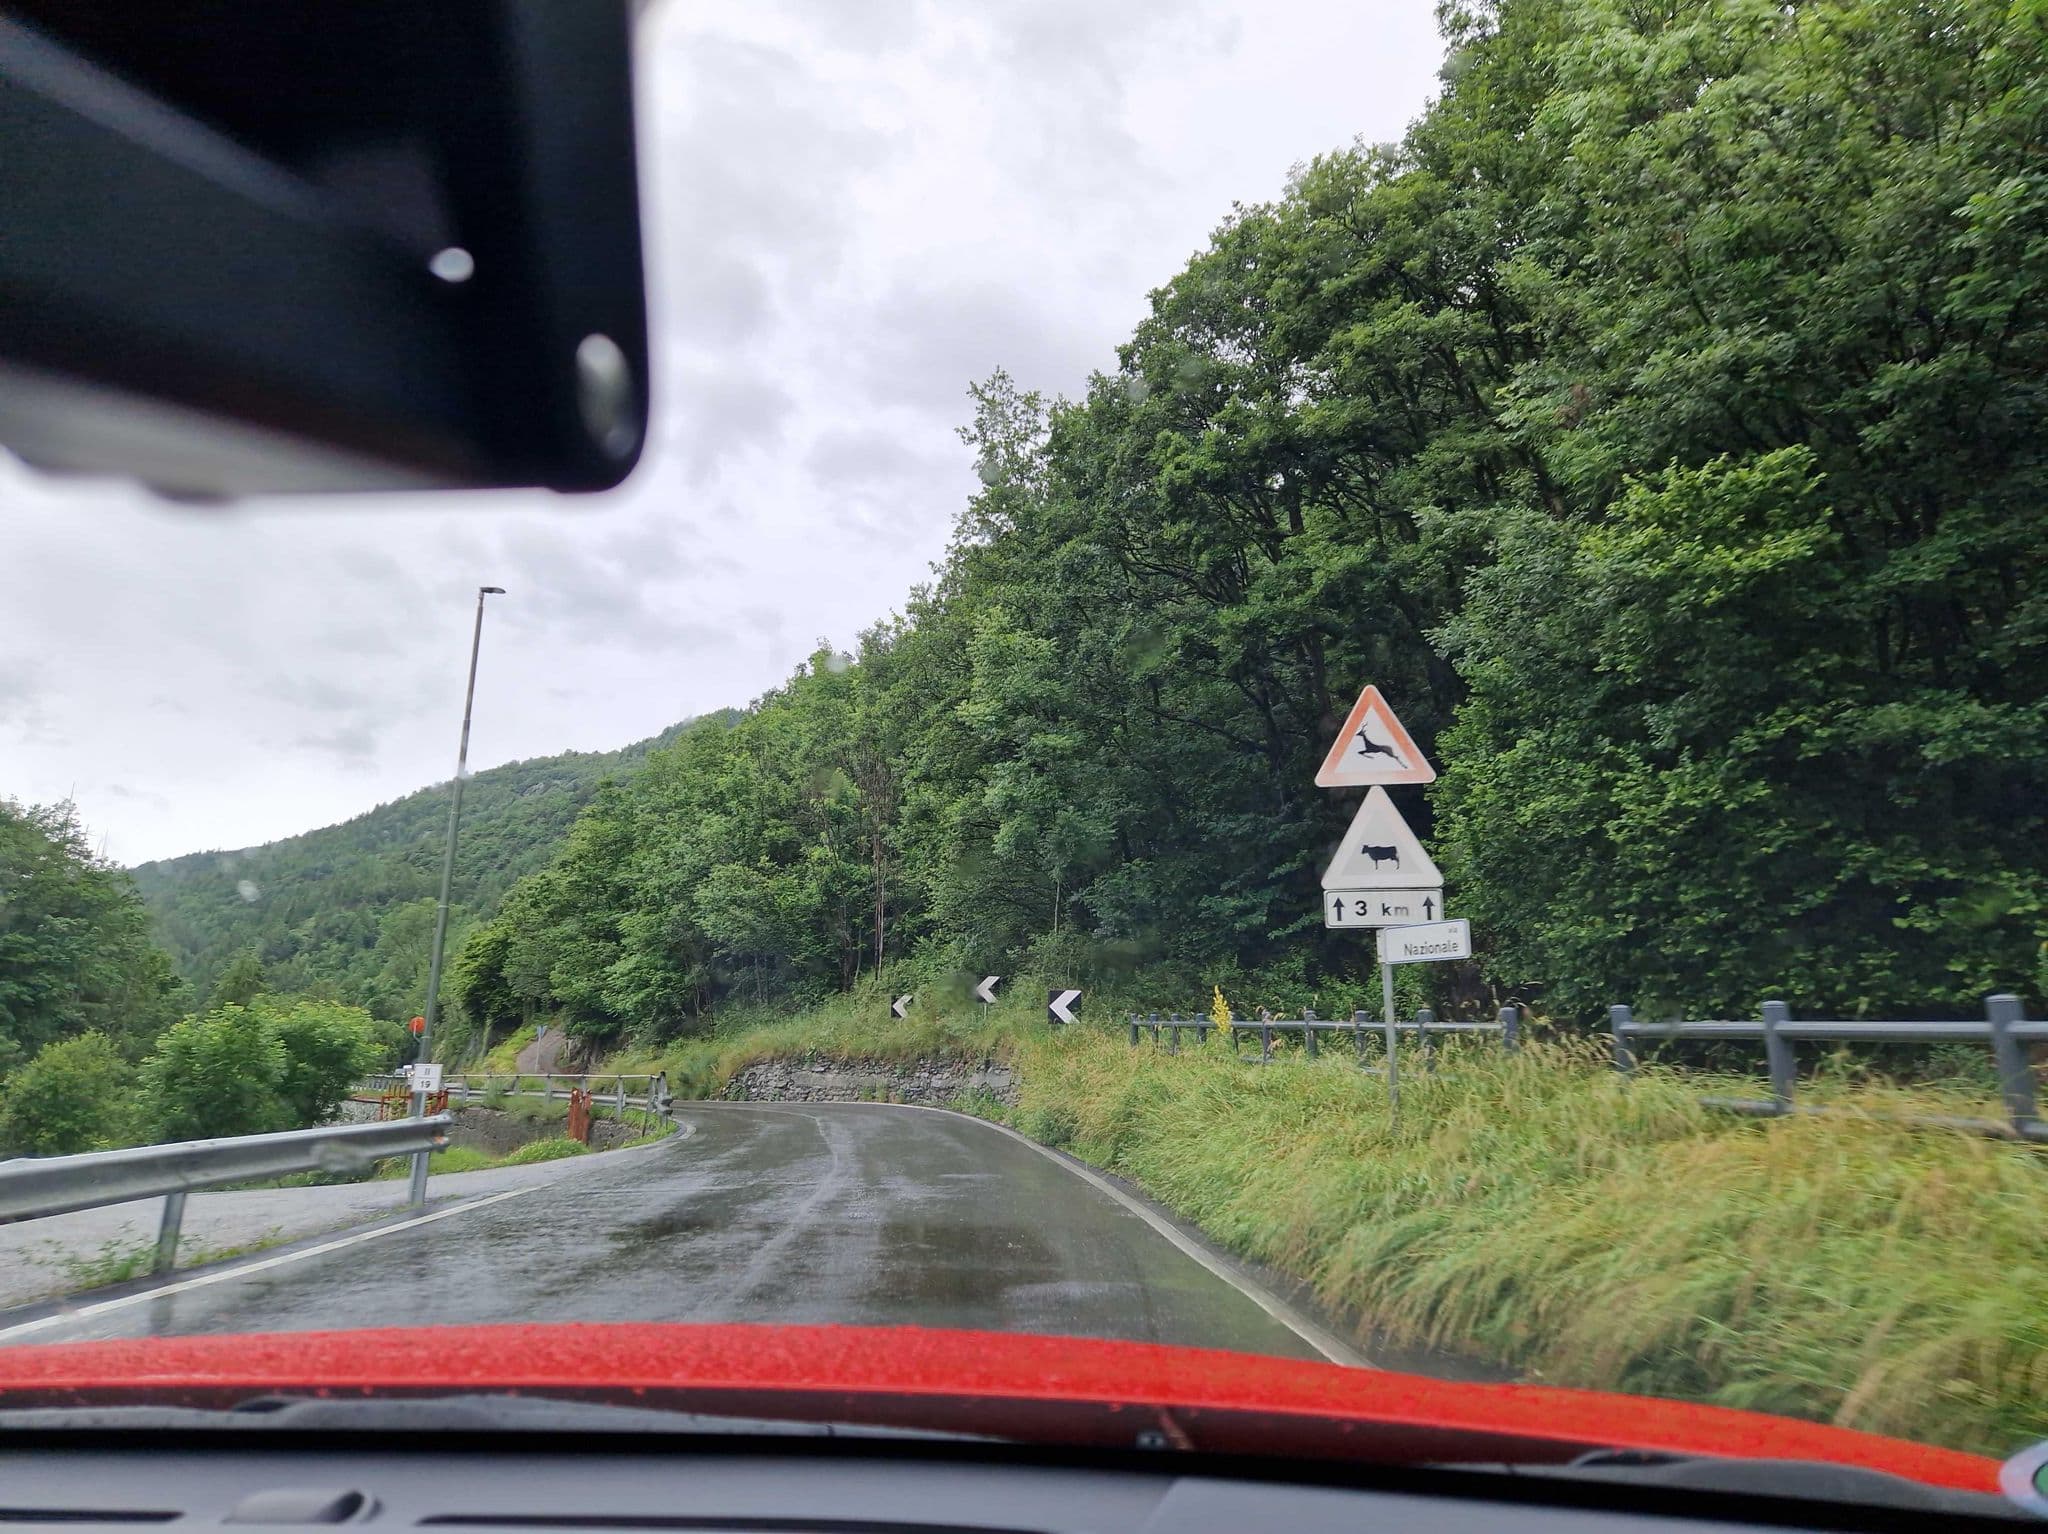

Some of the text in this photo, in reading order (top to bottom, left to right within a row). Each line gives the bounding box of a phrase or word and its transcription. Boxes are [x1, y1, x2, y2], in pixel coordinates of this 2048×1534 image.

[1355, 900, 1410, 917] 3 km
[1404, 940, 1459, 956] Nazionale
[420, 1080, 431, 1089] 19
